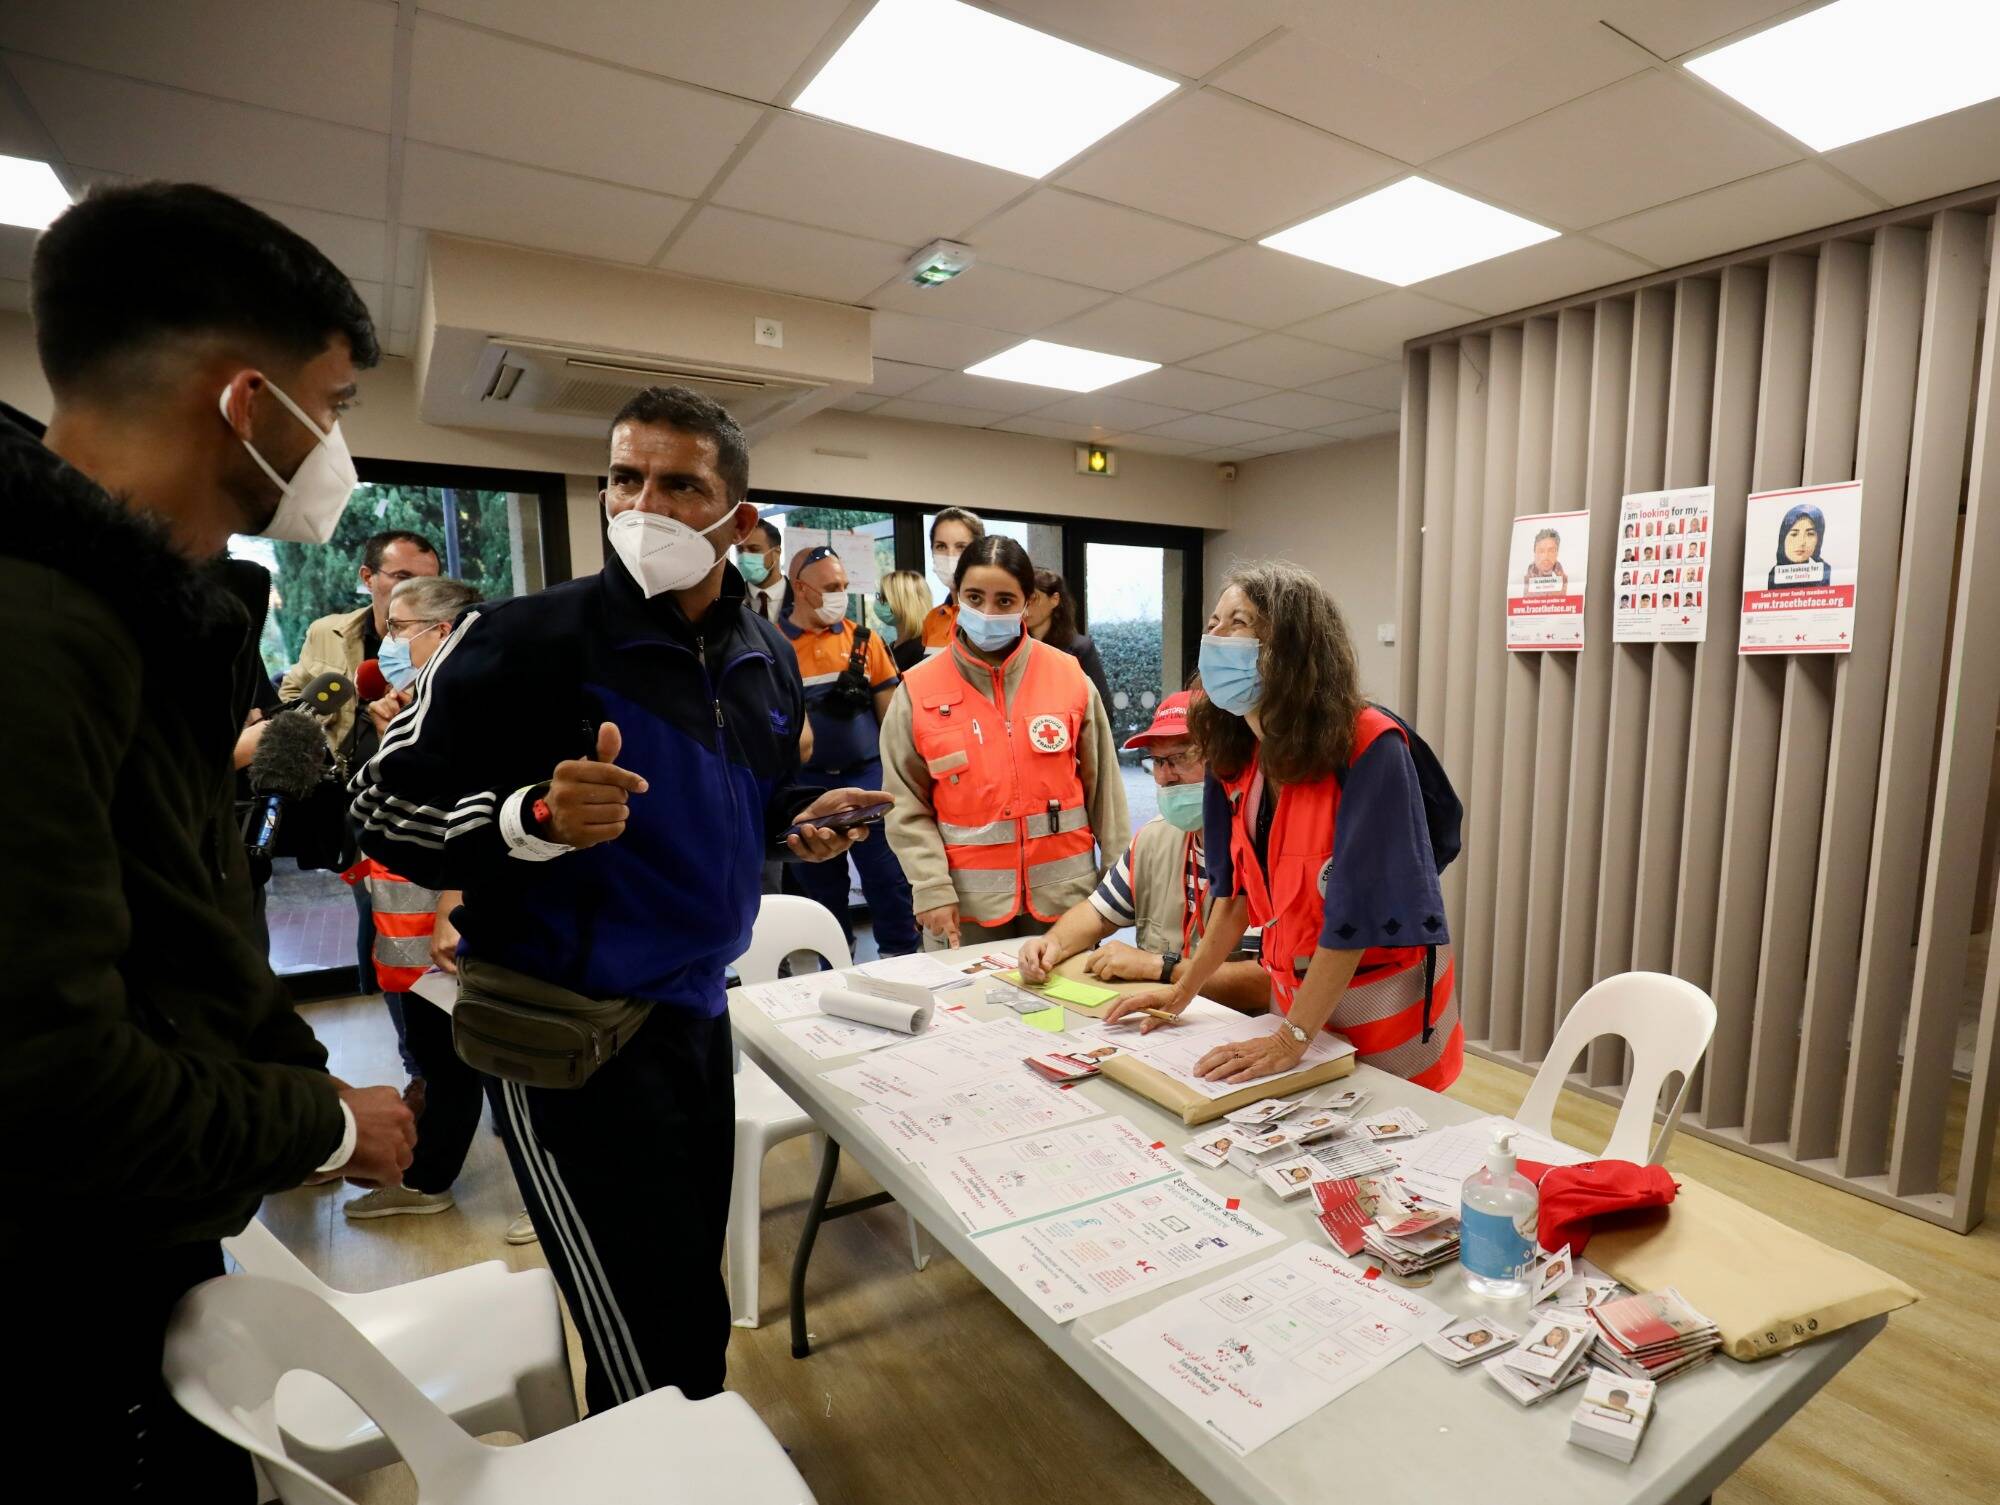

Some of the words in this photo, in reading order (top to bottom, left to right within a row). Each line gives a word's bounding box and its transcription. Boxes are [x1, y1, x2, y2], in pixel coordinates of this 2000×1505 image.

[1639, 508, 1670, 520] looking
[1671, 506, 1683, 516] for
[1685, 506, 1698, 516] my
[1752, 597, 1844, 610] www.tracetheface.org
[1322, 864, 1334, 881] CRO
